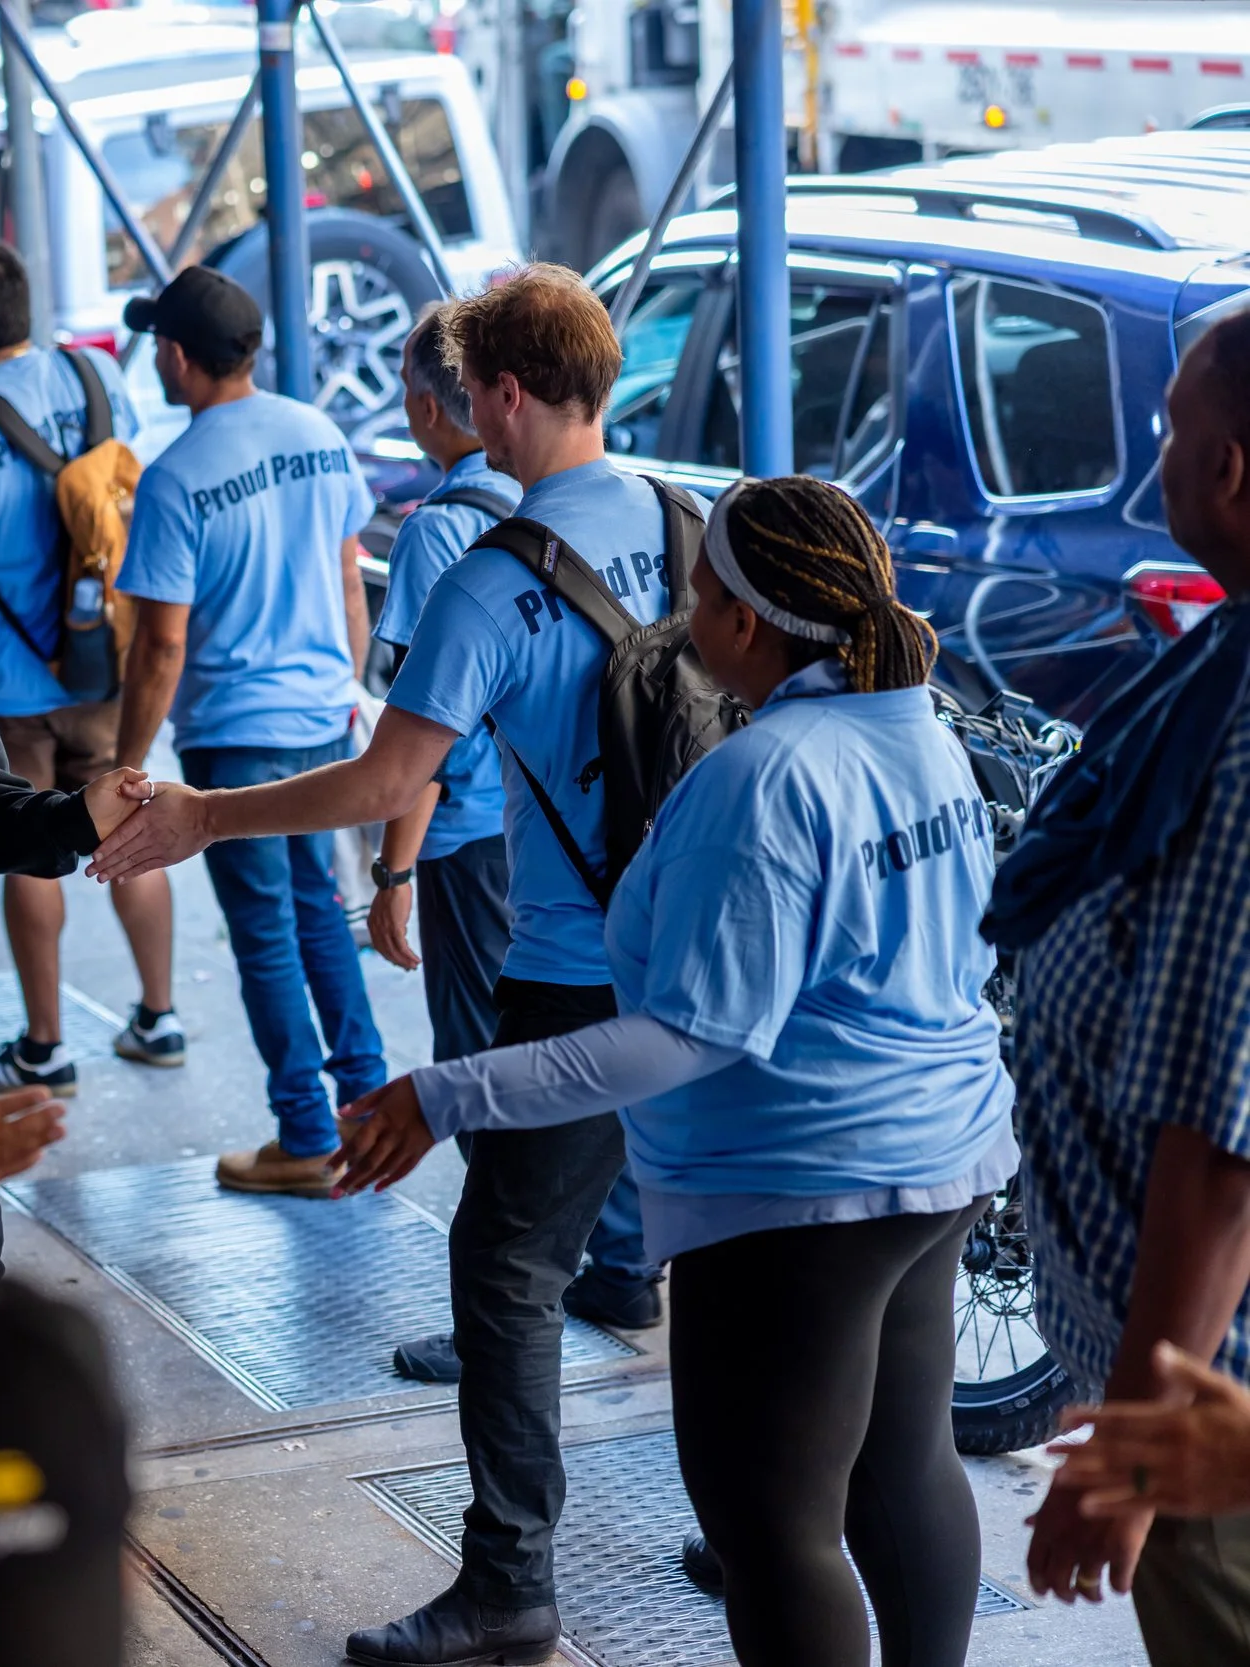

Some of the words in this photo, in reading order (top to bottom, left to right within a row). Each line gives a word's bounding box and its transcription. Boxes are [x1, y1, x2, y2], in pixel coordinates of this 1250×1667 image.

[192, 460, 267, 519] Proud
[271, 448, 349, 485] Parent
[861, 803, 951, 888] Proud
